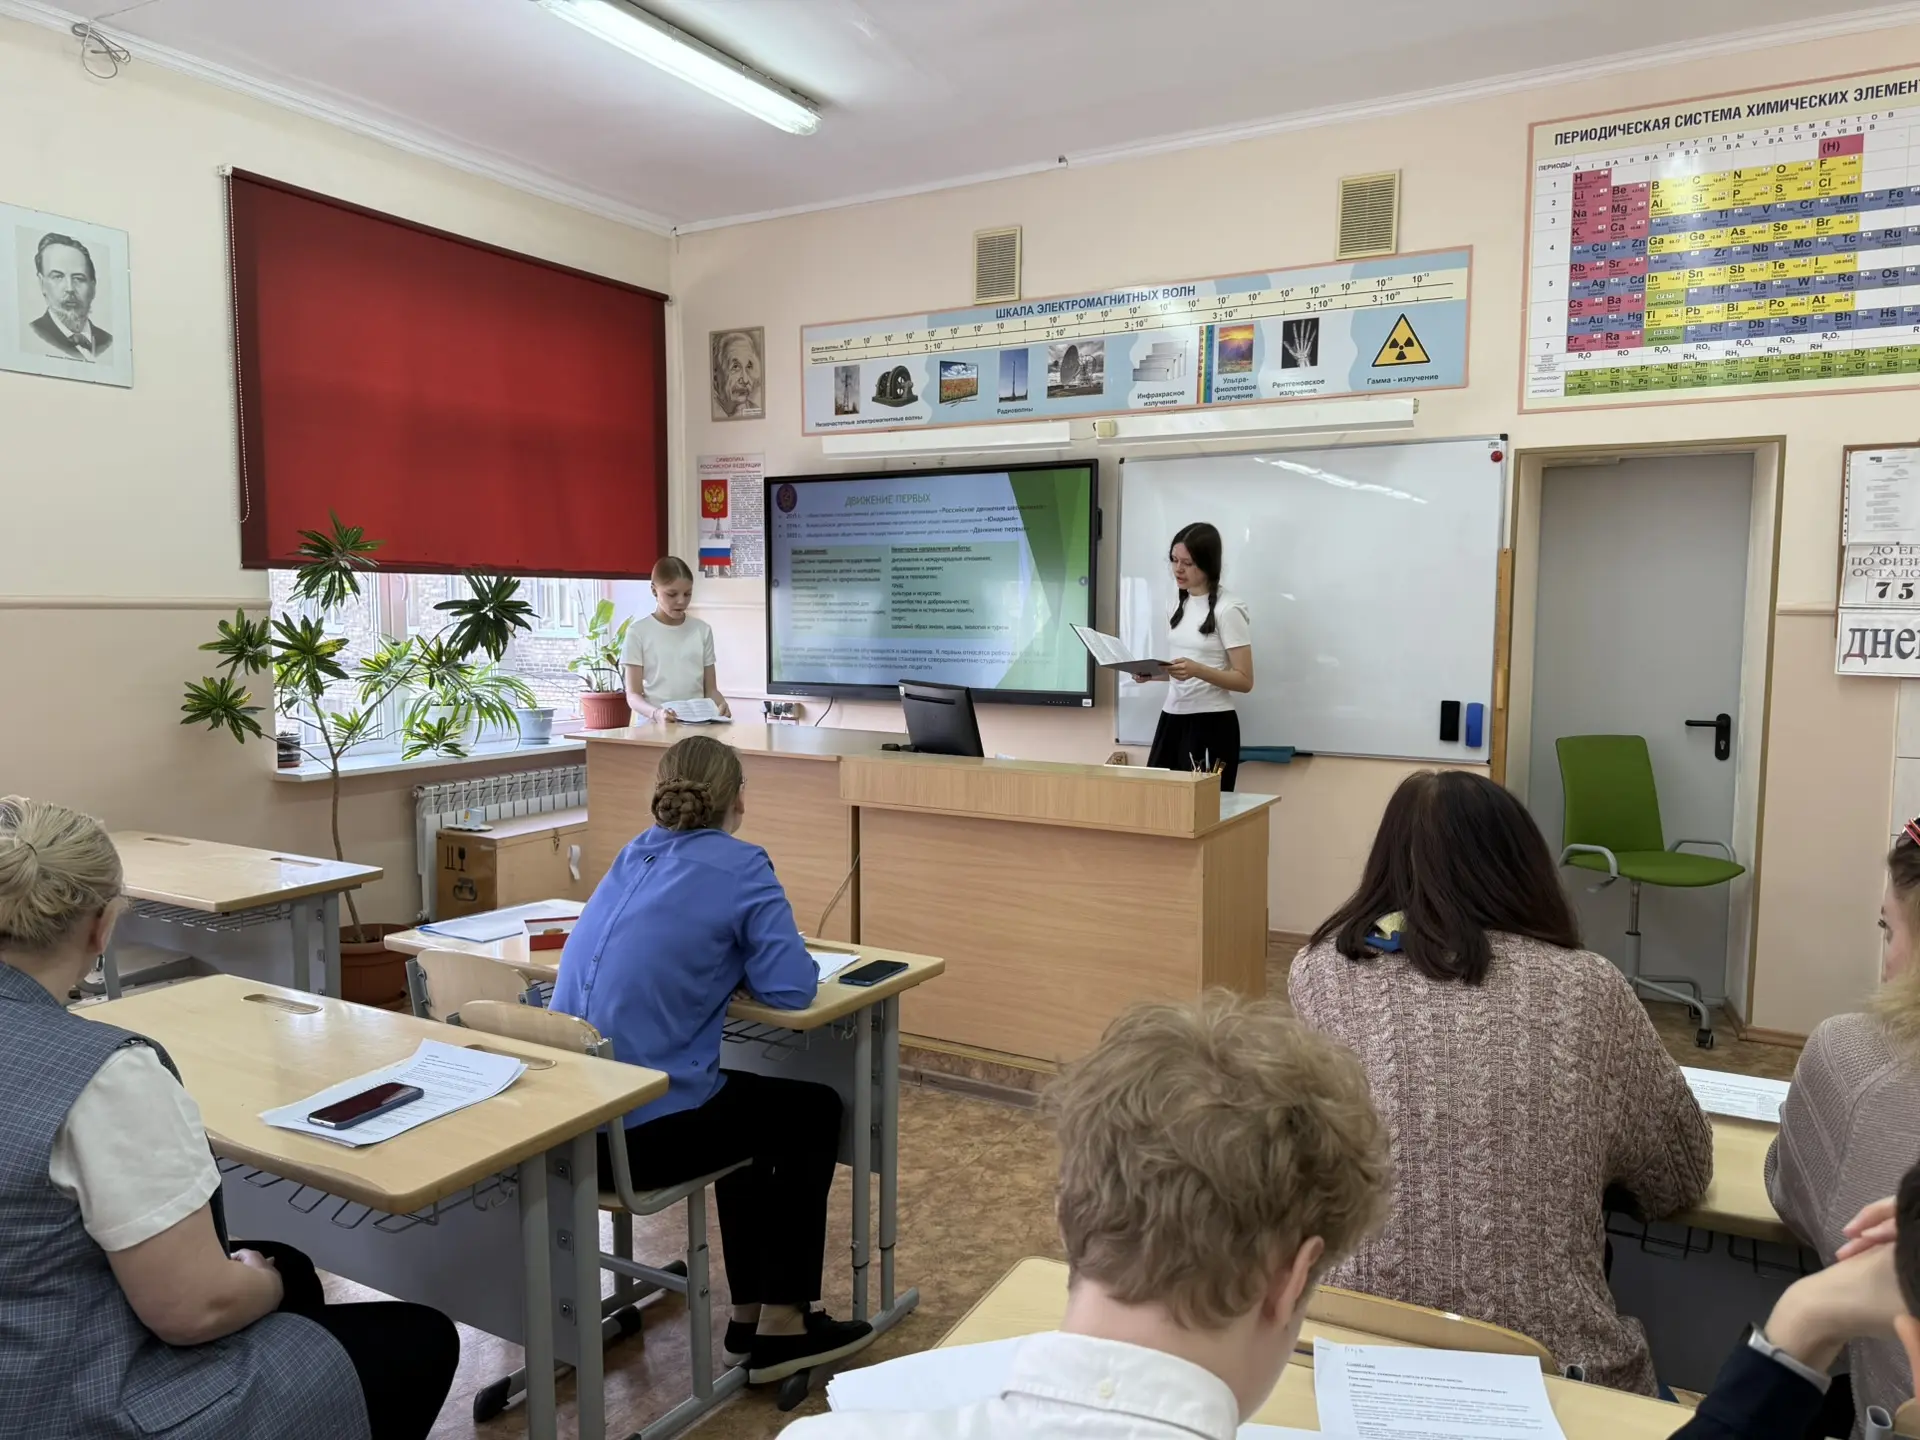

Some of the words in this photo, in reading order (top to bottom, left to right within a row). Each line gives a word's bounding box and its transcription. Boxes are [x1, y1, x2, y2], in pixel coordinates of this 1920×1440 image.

[1554, 117, 1670, 145] ПЕРИОДИЧЕСКАЯ
[1674, 106, 1742, 128] СИСТЕМА
[1747, 90, 1849, 117] ХИМИЧЕСКИХ
[1822, 142, 1840, 154] (H)
[1539, 162, 1572, 171] ПЕРИОДЫ
[1819, 160, 1827, 169] F
[1777, 165, 1786, 174] O
[1734, 170, 1741, 179] N
[1693, 176, 1700, 184] C
[1819, 178, 1831, 187] Cl
[1652, 181, 1659, 190] B
[1776, 184, 1783, 194] S
[1612, 186, 1626, 195] Be
[1733, 190, 1740, 198] P
[1889, 189, 1904, 198] Fe
[1574, 191, 1584, 200] Li
[1692, 194, 1702, 203] Si
[1651, 199, 1662, 208] Al
[1800, 200, 1814, 209] Cr
[1840, 196, 1858, 205] Mn
[1612, 205, 1627, 213] Mg
[1762, 205, 1771, 213] V
[1719, 210, 1728, 219] Ti
[1673, 216, 1686, 224] Sc
[1816, 218, 1830, 226] Br
[1611, 223, 1624, 231] Ca
[1773, 223, 1788, 232] Se
[1690, 232, 1704, 240] Ge
[1731, 228, 1745, 236] As
[1884, 229, 1901, 238] Ru
[1650, 237, 1664, 246] Ga
[1843, 234, 1856, 243] Tc
[1592, 244, 1606, 252] Cu
[1632, 239, 1645, 248] Zn
[1752, 244, 1768, 252] Nb
[1794, 240, 1812, 249] Mo
[1714, 249, 1727, 257] Zr
[1609, 260, 1621, 268] Sr
[1772, 261, 1785, 269] Te
[1815, 257, 1818, 266] I
[1571, 264, 1585, 272] Rb
[1730, 265, 1744, 274] Sb
[1648, 273, 1658, 282] In
[1688, 270, 1703, 278] Sn
[1838, 274, 1854, 282] Re
[1882, 269, 1899, 278] Os
[1591, 280, 1605, 288] Ag
[1630, 276, 1644, 284] Cd
[1798, 277, 1810, 286] W
[1713, 285, 1724, 294] Hf
[996, 306, 1034, 319] ШКАЛА
[1037, 289, 1159, 314] ЭЛЕКТРОМАГНИТНЫХ
[1162, 285, 1196, 299] ВОЛН
[1569, 300, 1582, 308] Cs
[1769, 300, 1784, 308] Po
[1812, 296, 1825, 304] At
[1686, 307, 1700, 316] Pb
[1727, 303, 1739, 311] Bi
[1628, 312, 1642, 321] Hg
[1646, 311, 1656, 319] Tl
[1835, 313, 1851, 321] Bh
[1880, 309, 1897, 318] Hs
[1588, 316, 1603, 324] Au
[1748, 320, 1764, 328] Db
[1792, 316, 1807, 325] Sg
[1710, 324, 1723, 332] Rf
[1568, 336, 1579, 344] Fr
[1606, 332, 1620, 341] Ra
[1223, 376, 1249, 384] Ультра-
[1398, 374, 1439, 382] излучение
[1272, 378, 1325, 388] Рентгеновское
[1214, 384, 1257, 393] фиолетовое
[1279, 387, 1317, 396] излучение
[1137, 390, 1185, 400] Инфракрасное
[1218, 392, 1253, 401] излучение
[815, 419, 855, 428] Низкочастотные
[856, 416, 904, 425] электромагнитные
[845, 494, 893, 508] ДВИЖЕНИЕ
[896, 493, 930, 503] ПЕРВЫХ
[1869, 545, 1893, 556] ДО
[1898, 544, 1920, 555] ЕГ
[1851, 557, 1874, 566] ПО
